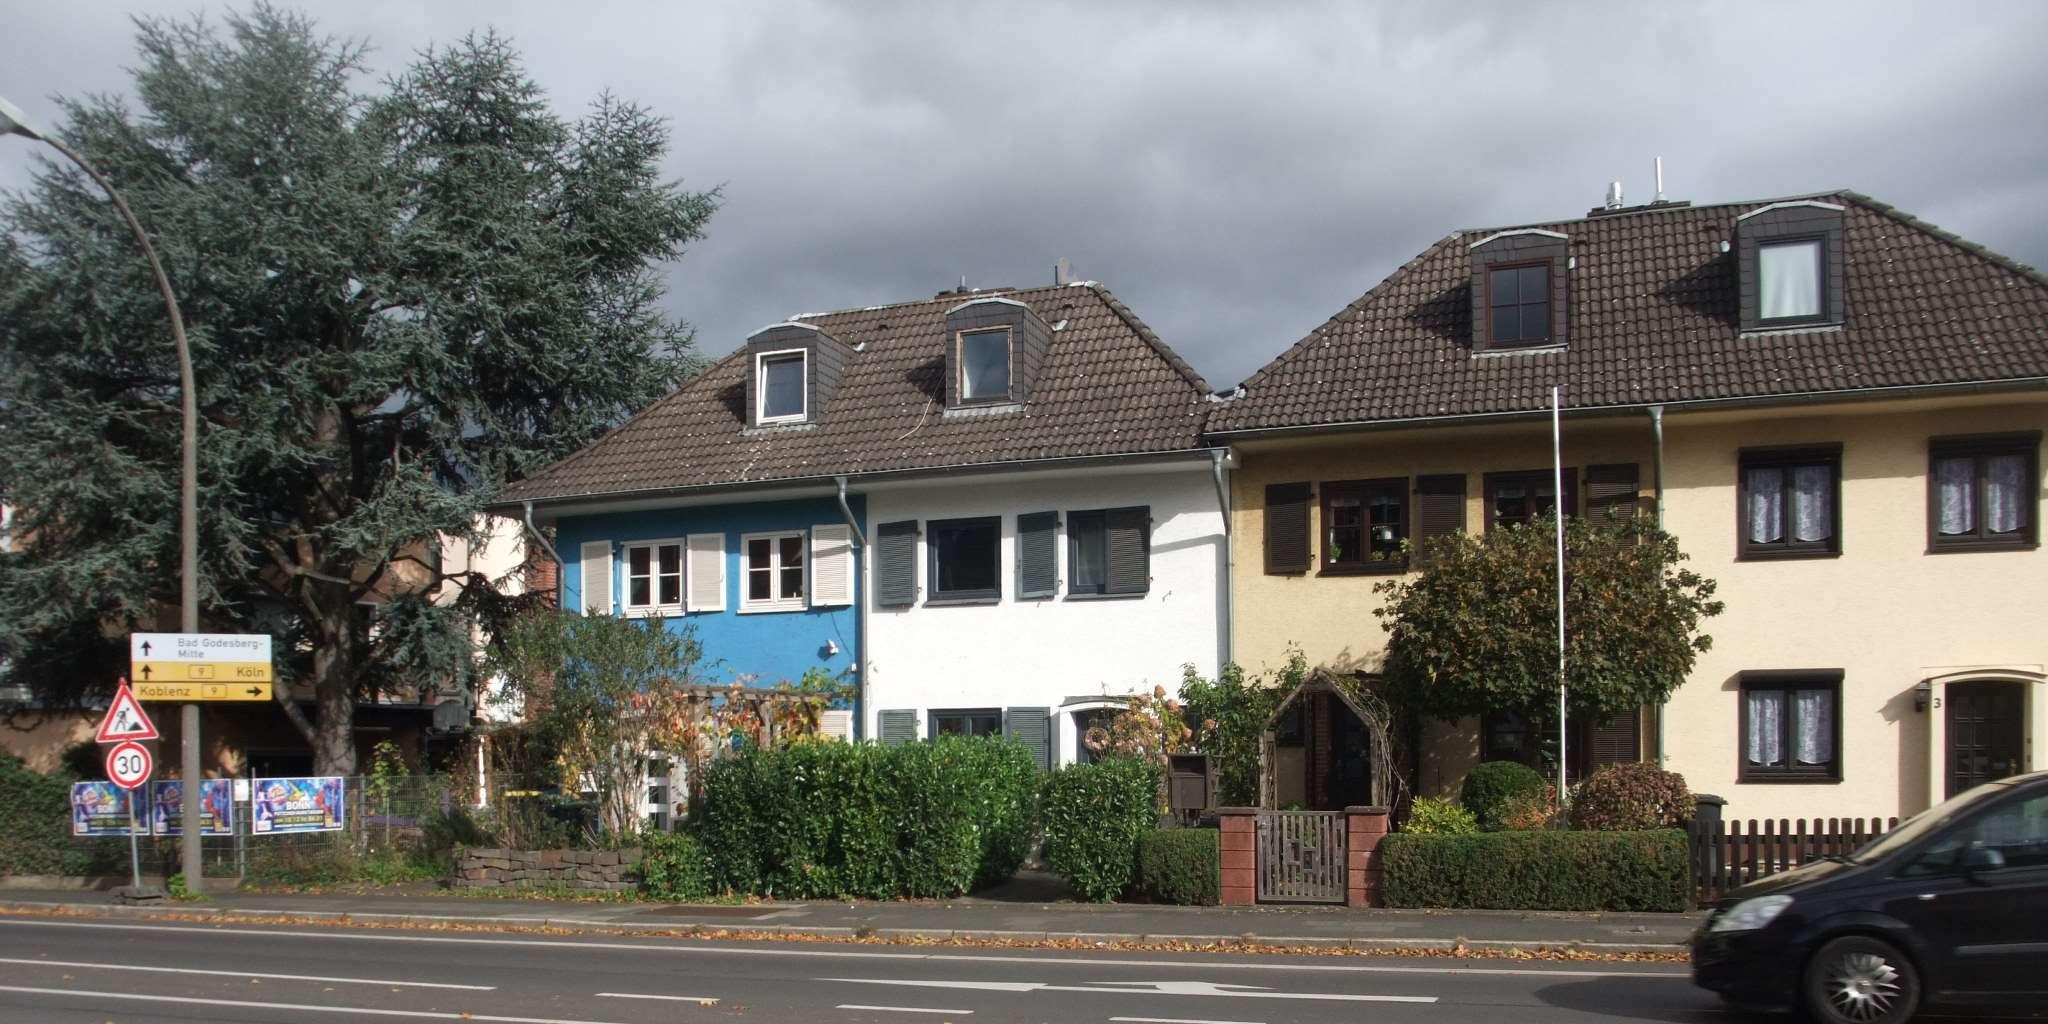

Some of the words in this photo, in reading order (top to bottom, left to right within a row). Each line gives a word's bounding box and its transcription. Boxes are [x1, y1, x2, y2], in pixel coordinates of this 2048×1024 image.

[178, 638, 199, 647] Bad
[202, 638, 263, 650] Godesberg-
[178, 649, 205, 658] Mitte
[199, 667, 205, 676] 9
[236, 666, 264, 677] Köln
[139, 687, 191, 697] Koblenz
[211, 687, 217, 696] 9
[1933, 697, 1942, 709] 3
[118, 755, 141, 775] 30
[286, 801, 311, 810] BONN
